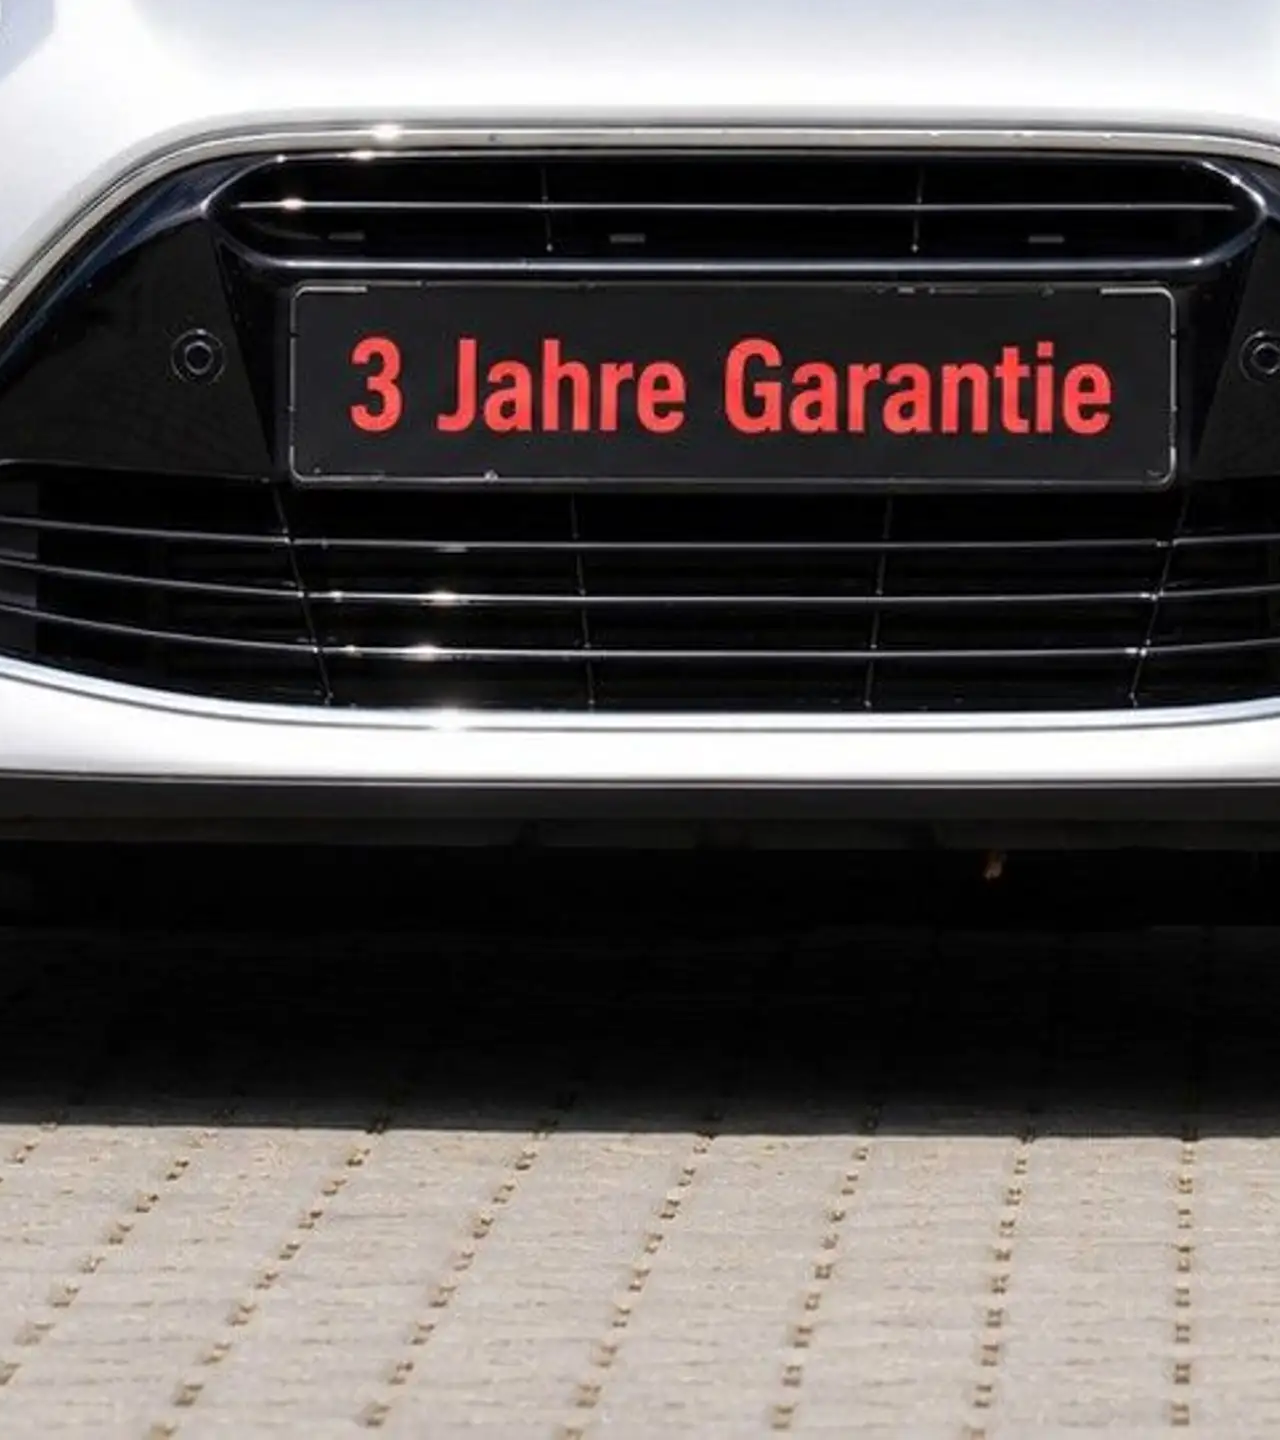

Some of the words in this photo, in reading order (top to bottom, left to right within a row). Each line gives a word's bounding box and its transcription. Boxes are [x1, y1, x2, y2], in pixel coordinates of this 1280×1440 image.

[350, 336, 403, 433] 3
[436, 337, 686, 434] Jahre
[724, 337, 1113, 435] Garantie
